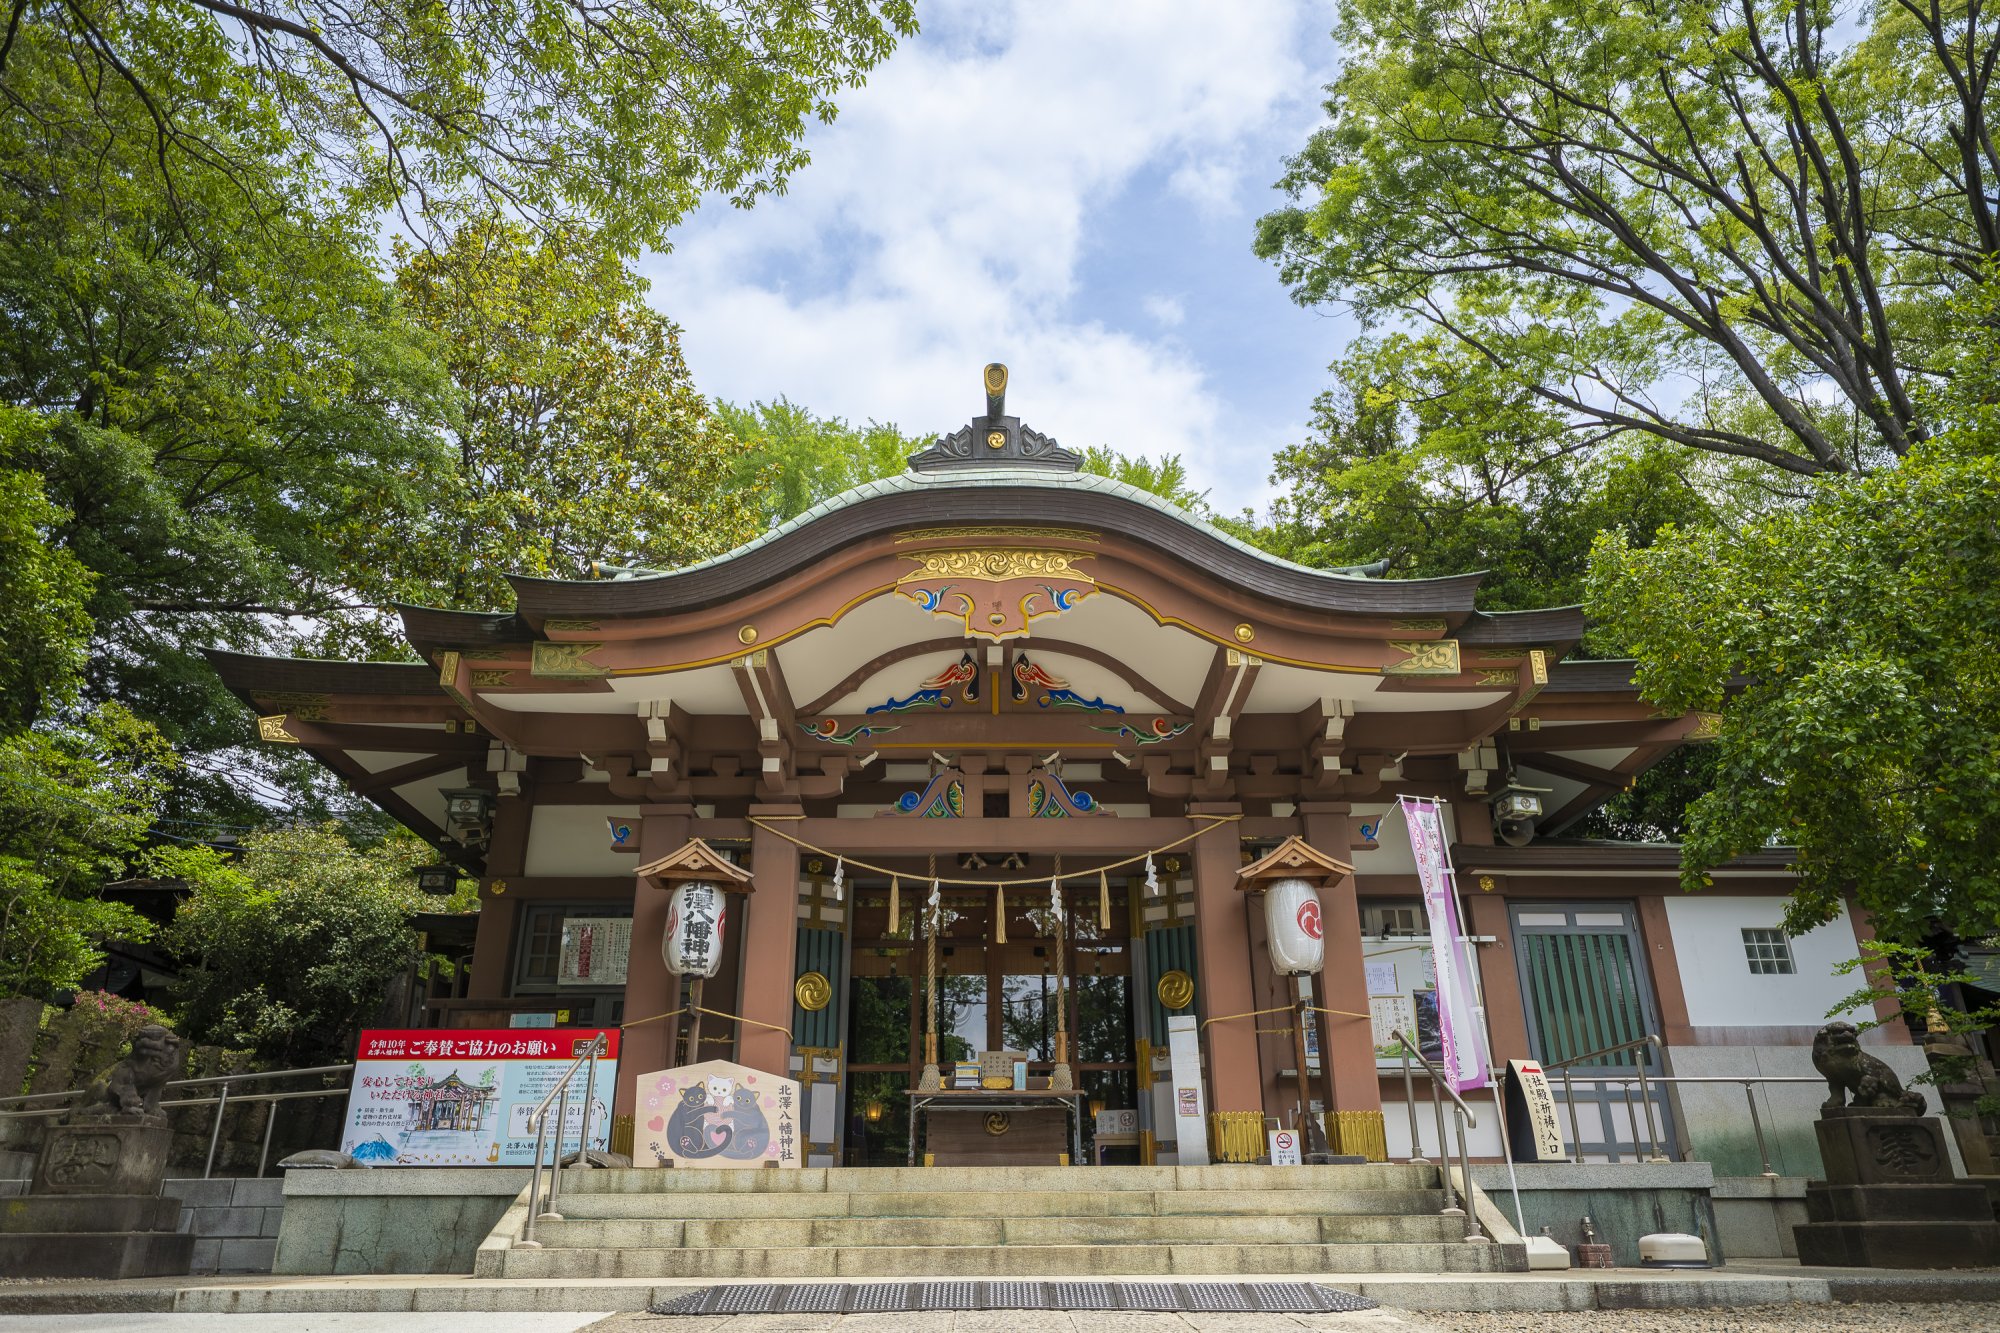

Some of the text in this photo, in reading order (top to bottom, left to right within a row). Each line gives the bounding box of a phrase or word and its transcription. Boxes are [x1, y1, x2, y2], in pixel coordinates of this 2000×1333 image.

[680, 882, 715, 969] 北澤八幡神社
[369, 1040, 407, 1048] 令和10年
[410, 1040, 557, 1056] ご奉賛ご協力のお願い
[361, 1076, 435, 1088] 安心してお参り
[370, 1090, 457, 1101] いただける神社へ
[1531, 1075, 1558, 1154] 社殿祈祷入口
[778, 1085, 795, 1161] 北澤八幡神社
